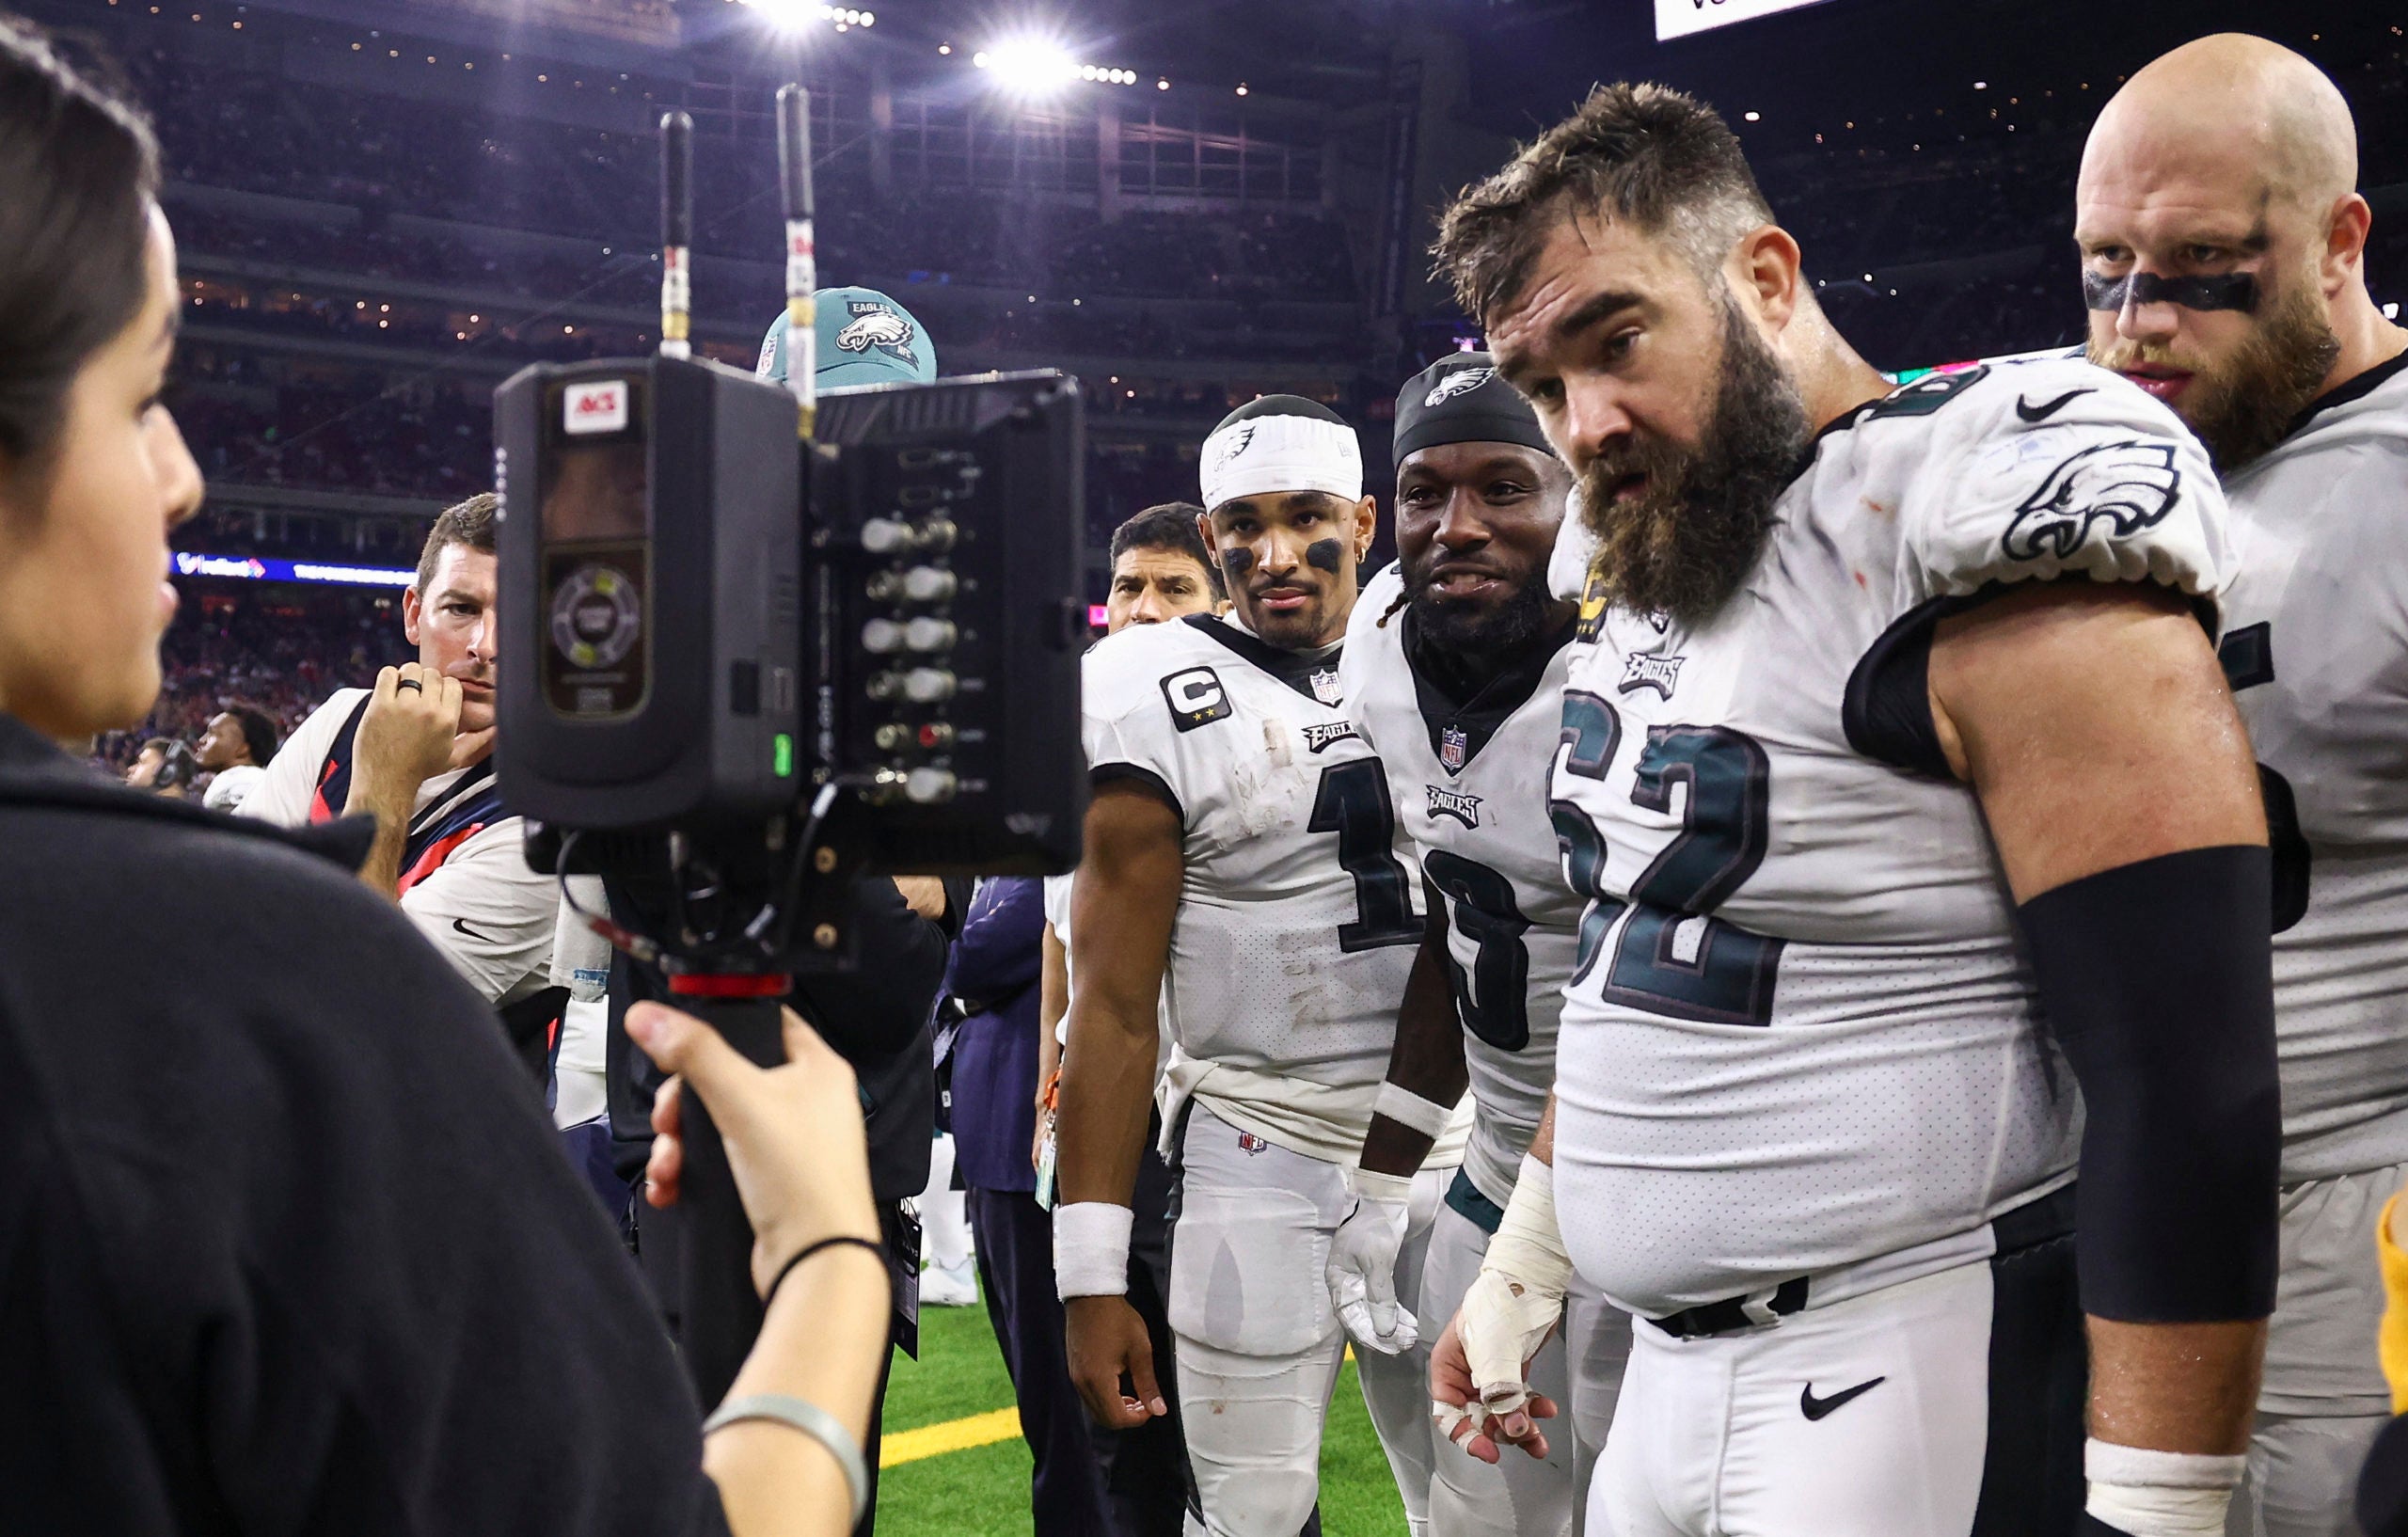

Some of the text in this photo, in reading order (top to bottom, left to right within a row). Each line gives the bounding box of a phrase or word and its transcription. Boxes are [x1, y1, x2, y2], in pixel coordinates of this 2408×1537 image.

[1167, 670, 1222, 714] C
[1318, 684, 1339, 699] NFL
[1618, 652, 1687, 702] EAGLES
[1444, 743, 1461, 764] NFL
[1426, 784, 1483, 830] EAGLES
[1307, 755, 1427, 953] 1
[1546, 689, 1785, 1027] 62
